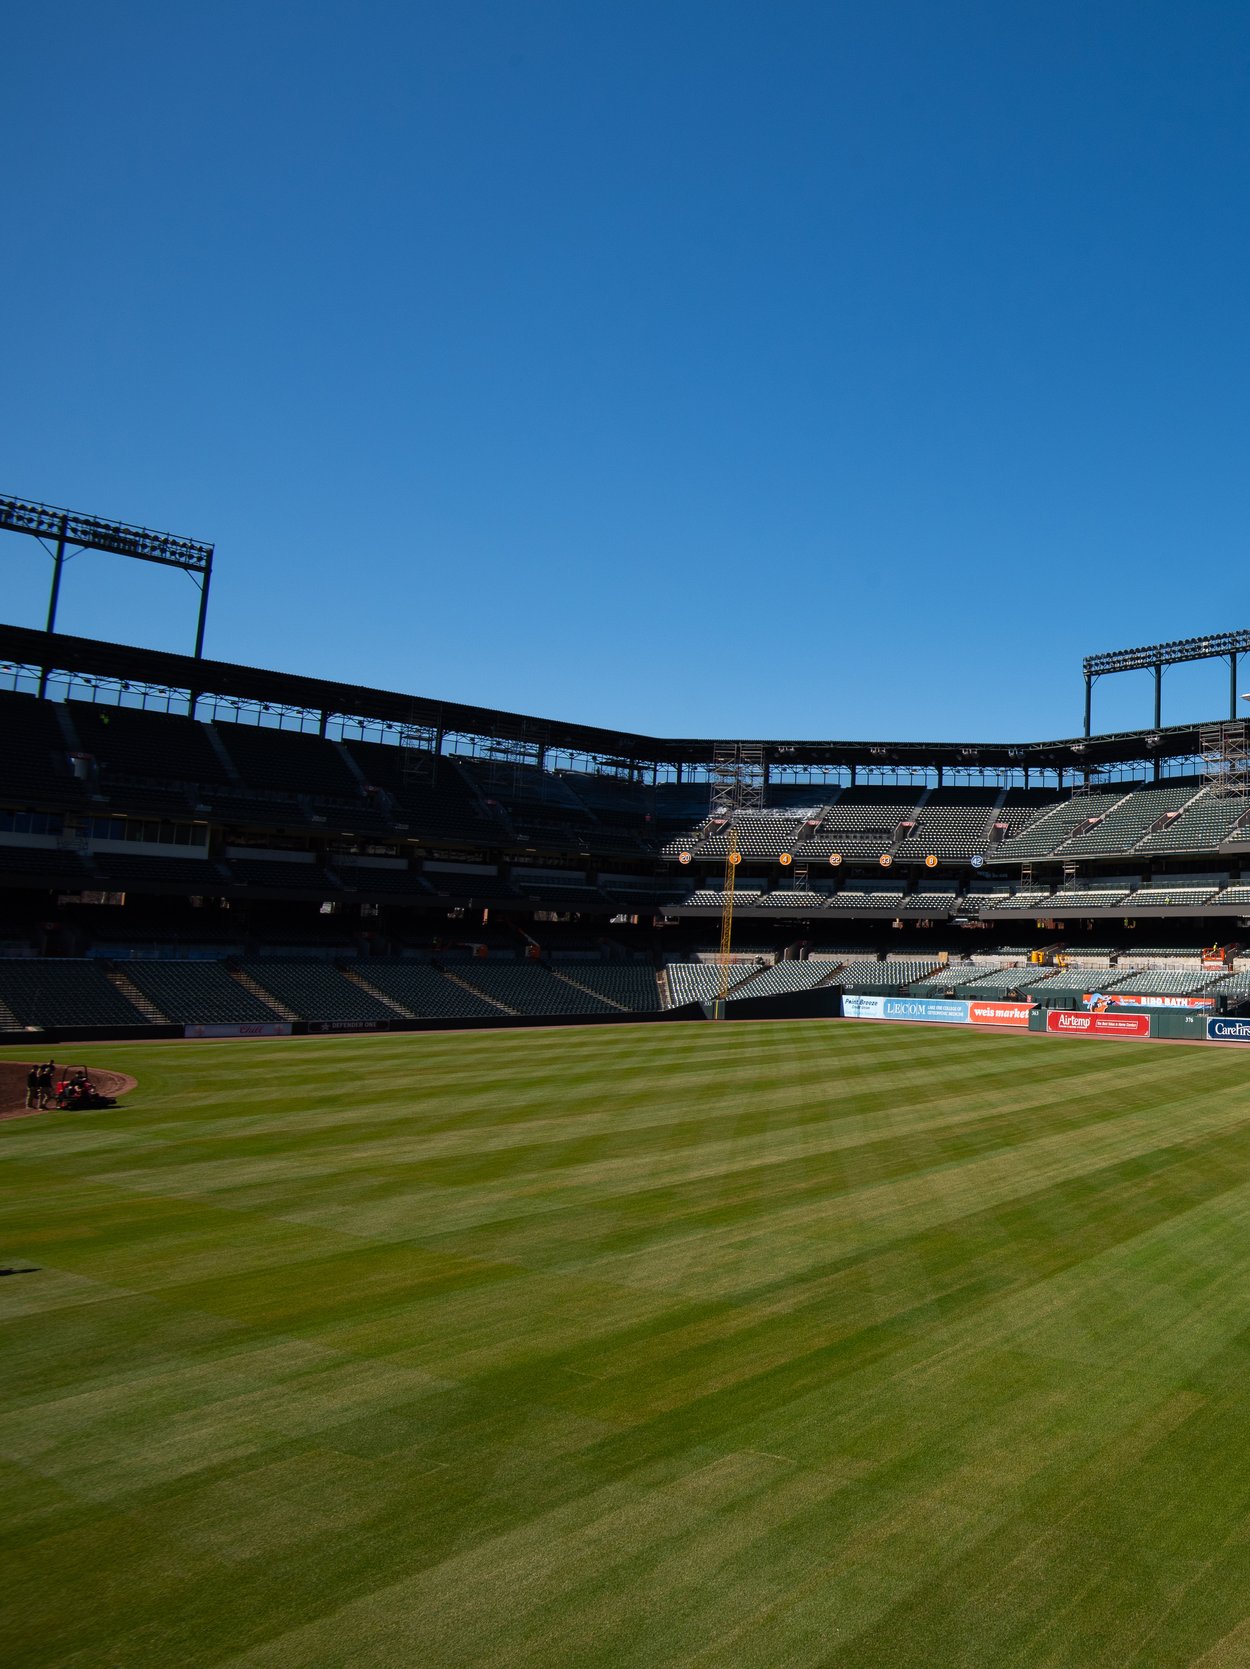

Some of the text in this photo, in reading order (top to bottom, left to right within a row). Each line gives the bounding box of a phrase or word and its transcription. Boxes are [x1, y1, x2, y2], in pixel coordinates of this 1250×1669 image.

[1164, 998, 1188, 1007] BATH
[974, 1007, 994, 1017] weis
[1059, 1014, 1090, 1027] Airtemp
